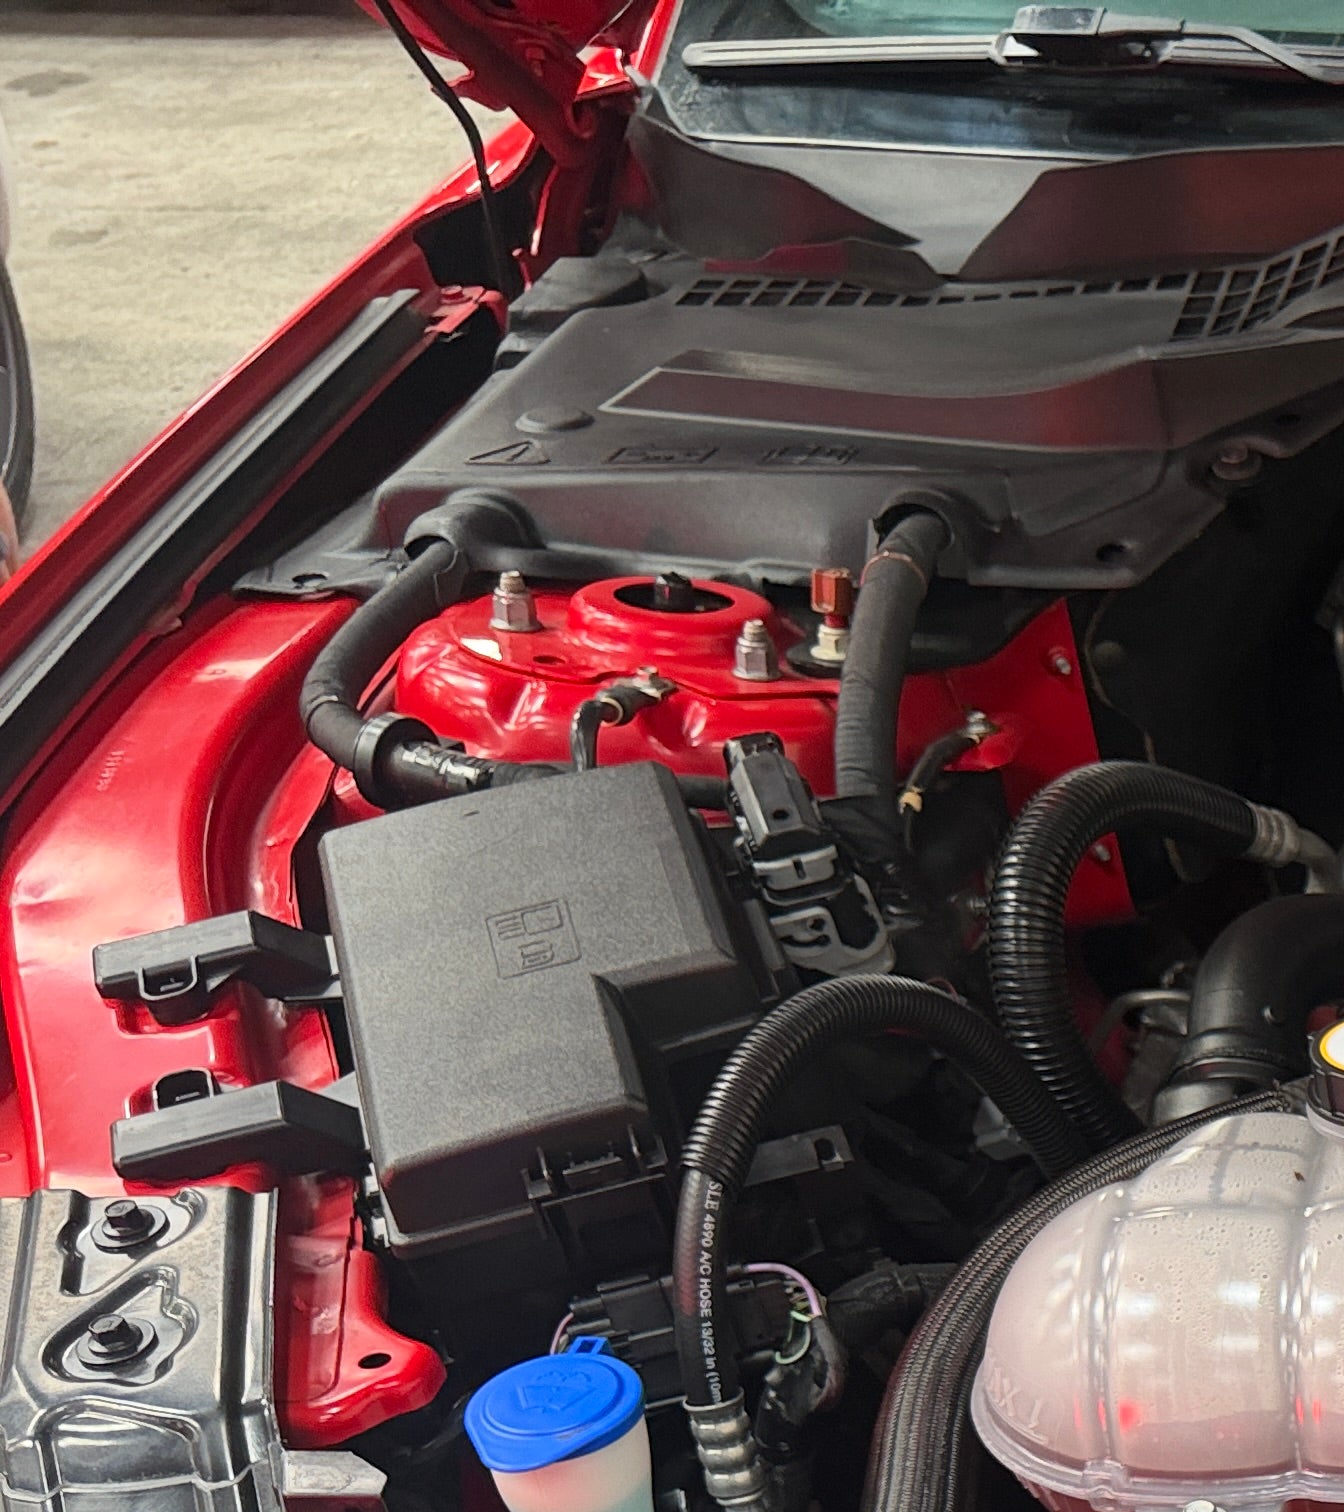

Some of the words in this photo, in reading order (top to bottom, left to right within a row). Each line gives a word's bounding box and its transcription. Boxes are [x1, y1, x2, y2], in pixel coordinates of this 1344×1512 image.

[704, 1180, 724, 1211] SLE
[701, 1213, 717, 1248] 4890
[699, 1250, 713, 1276] A/C
[699, 1278, 712, 1318] HOSE
[701, 1320, 716, 1356] 13/32
